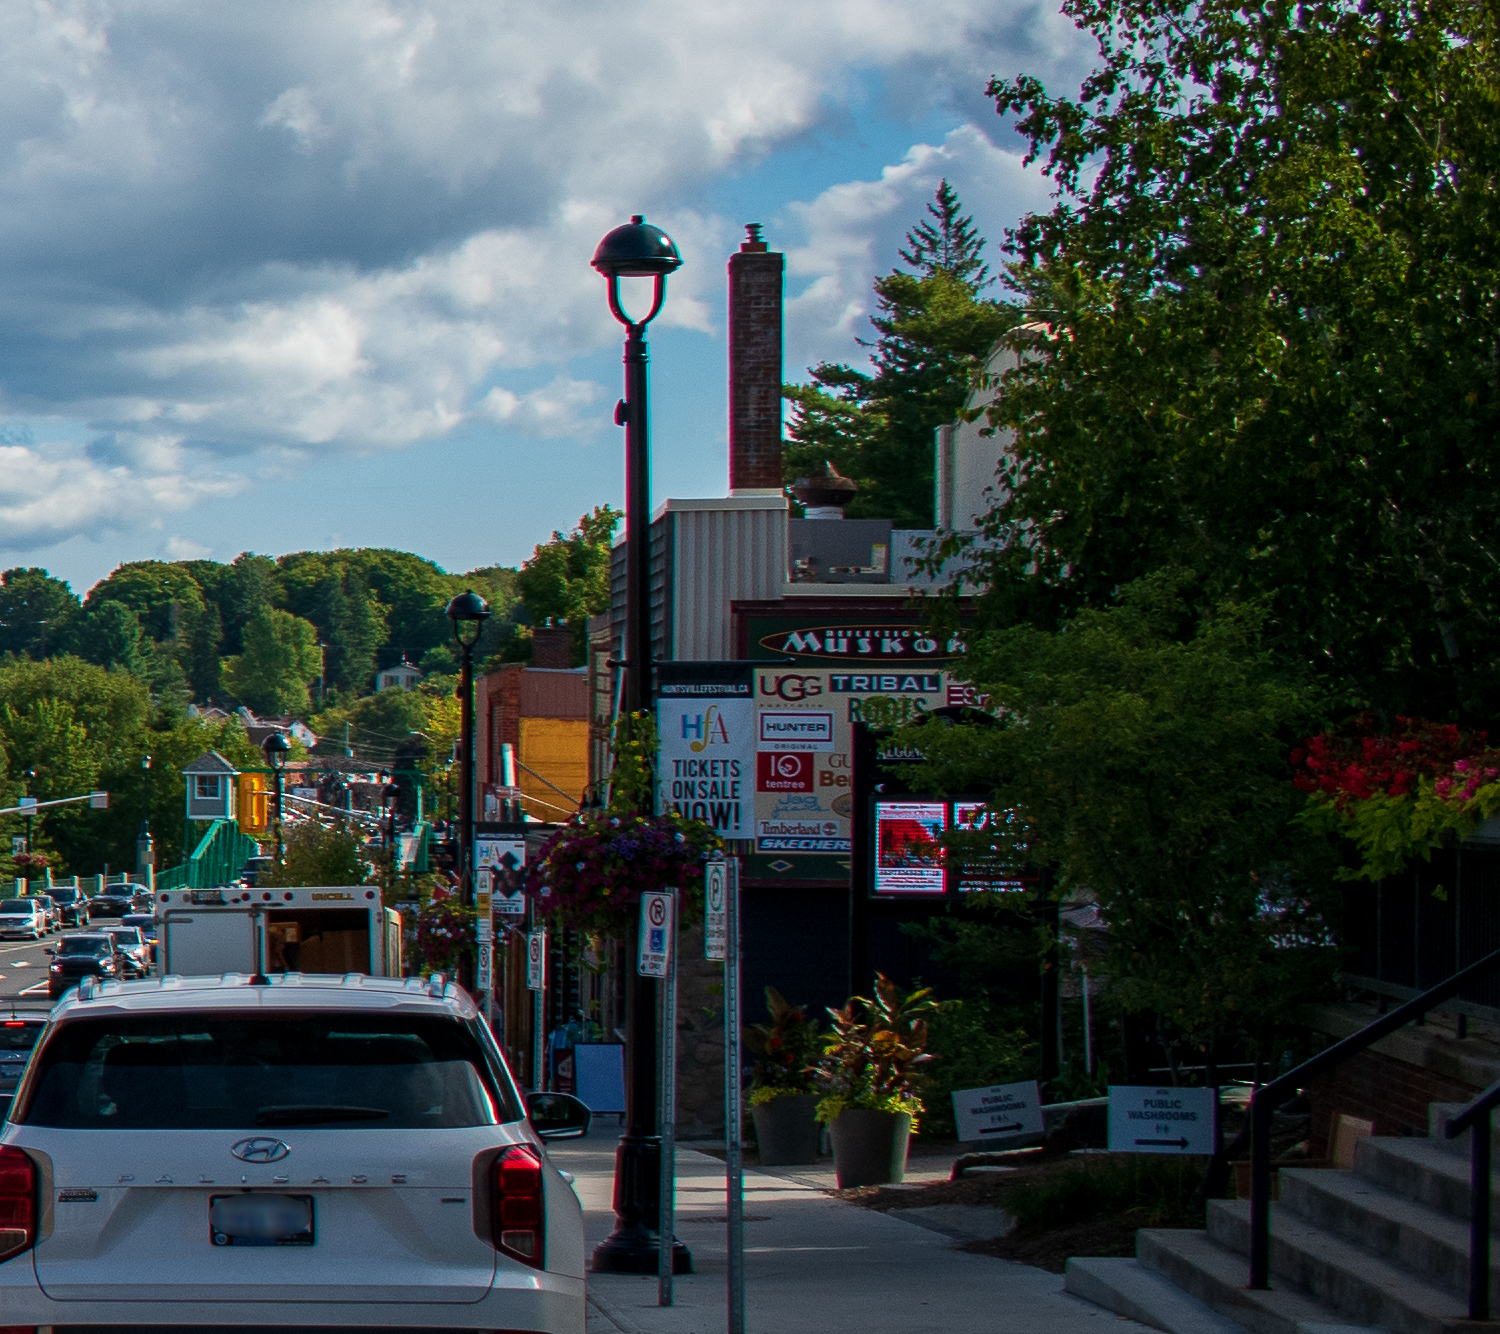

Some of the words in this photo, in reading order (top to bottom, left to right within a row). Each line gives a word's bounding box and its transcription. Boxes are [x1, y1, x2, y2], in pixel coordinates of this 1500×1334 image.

[661, 684, 750, 694] HUNTSVILLEFESTIVAL.CA
[759, 673, 823, 703] UGG
[831, 675, 939, 692] TRIBAL
[765, 723, 827, 732] HUNTER
[672, 759, 741, 778] TICKETS
[765, 779, 806, 789] tentree
[760, 821, 821, 835] Timberland
[981, 1093, 1014, 1105] PUBLIC
[1143, 1098, 1182, 1109] PUBLIC
[970, 1100, 1027, 1116] WASHROOMS
[1127, 1110, 1199, 1121] WASHROOMS
